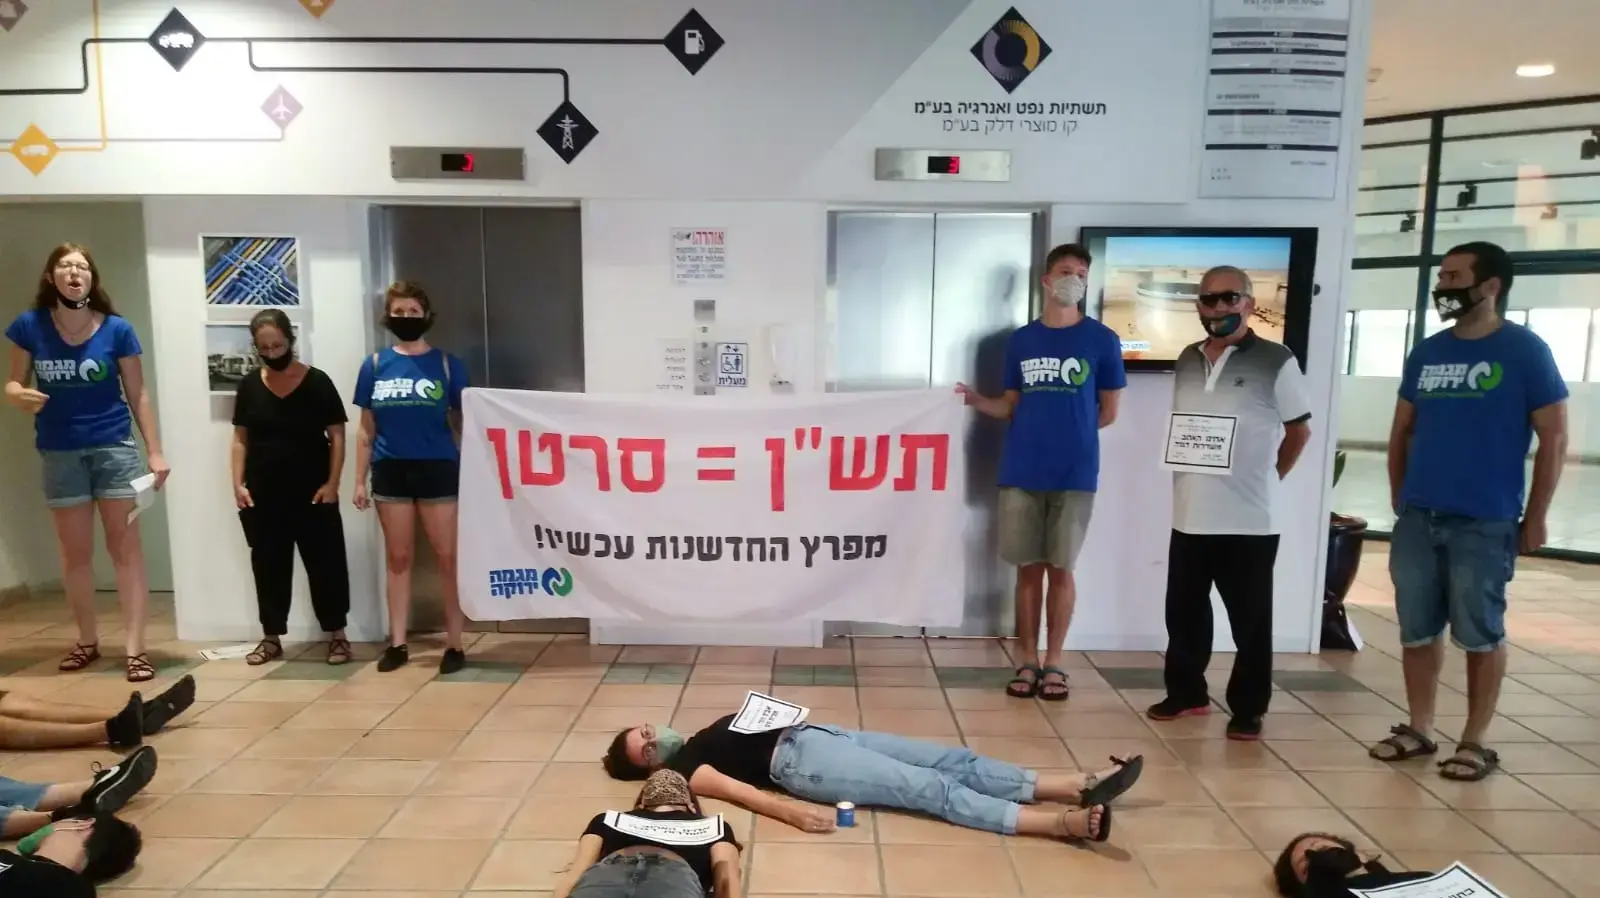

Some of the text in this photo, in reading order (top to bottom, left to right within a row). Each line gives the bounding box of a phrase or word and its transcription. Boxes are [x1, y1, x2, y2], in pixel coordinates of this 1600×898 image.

[914, 101, 1107, 115] תשתיות נפט ואנרגיה בע"מ
[942, 117, 1078, 136] קו מוצרי דלק בע"מ
[948, 156, 960, 174] 3
[1420, 363, 1469, 378] מגמה
[718, 375, 747, 386] מעלית
[486, 426, 949, 512] תש"ן = סרטן
[534, 524, 888, 568] מפרץ החדשנות עכשיו!
[489, 568, 538, 584] מגמה
[490, 581, 539, 600] ירוקה
